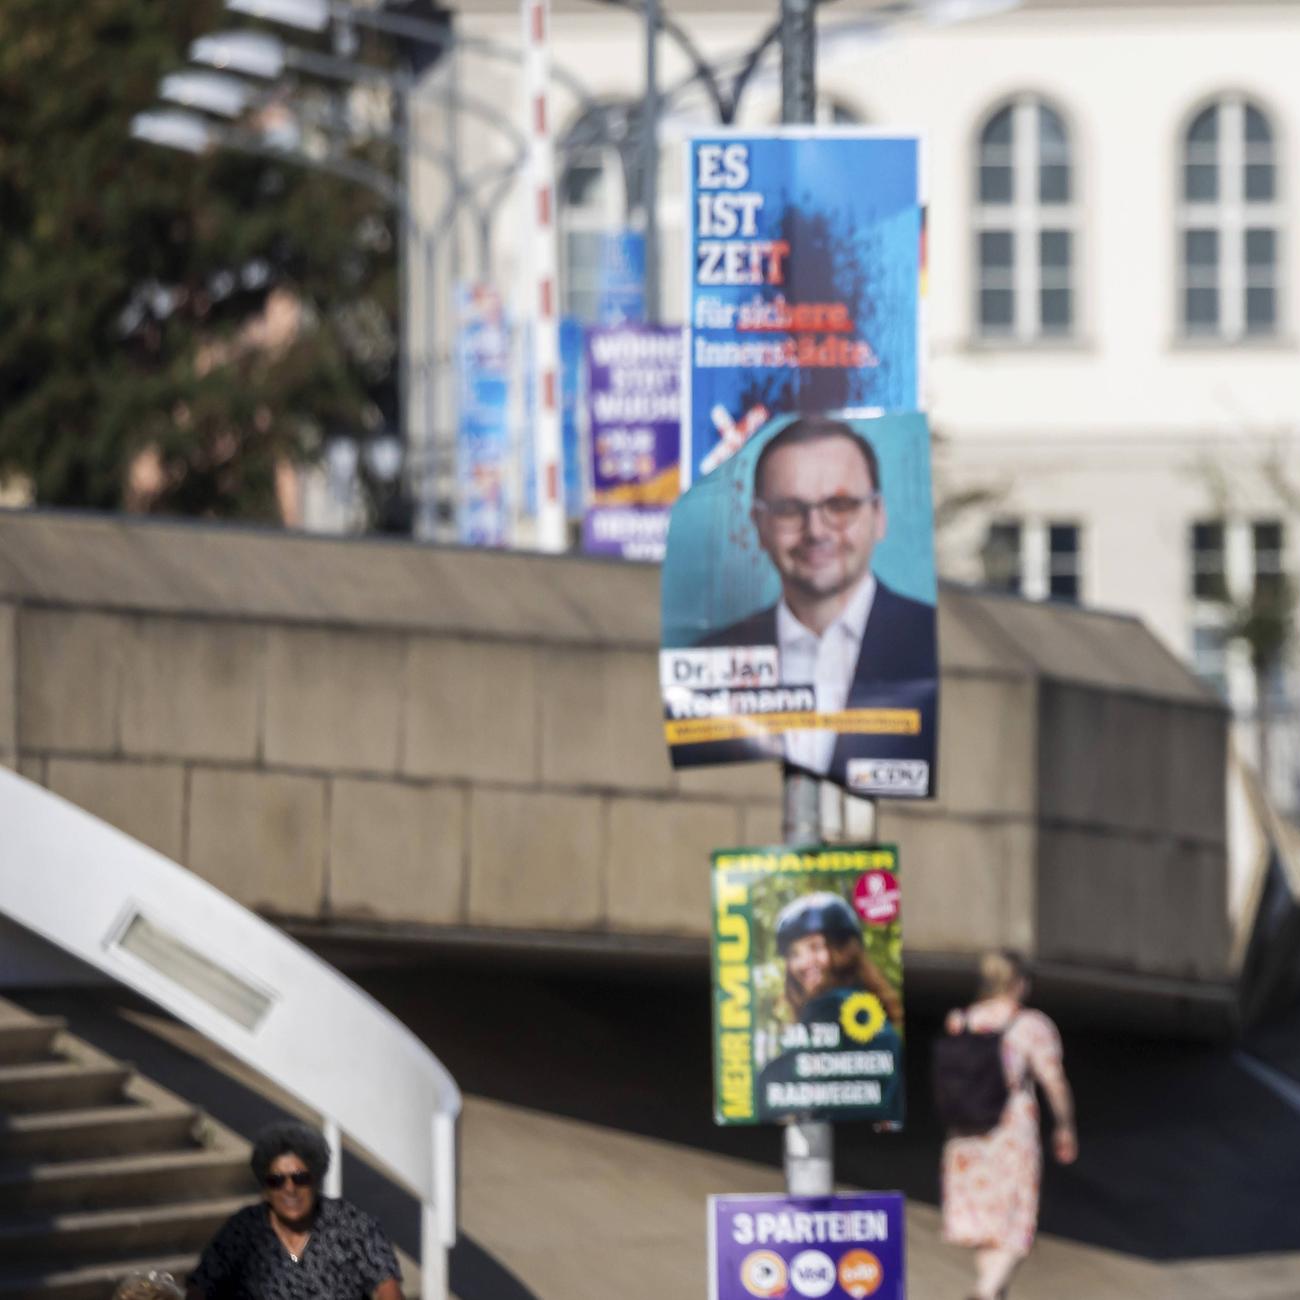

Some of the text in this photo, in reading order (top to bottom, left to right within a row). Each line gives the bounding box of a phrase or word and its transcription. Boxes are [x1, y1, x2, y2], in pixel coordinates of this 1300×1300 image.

[697, 144, 749, 189] ES
[697, 191, 764, 238] IST
[697, 239, 790, 286] ZEIT
[695, 296, 736, 329] für
[673, 655, 773, 682] Dr. Jan
[716, 851, 896, 872] EINANDER
[717, 868, 753, 1118] MEHR MUT
[782, 1023, 840, 1048] JA ZU
[732, 1209, 889, 1244] 3 PARTEIEN
